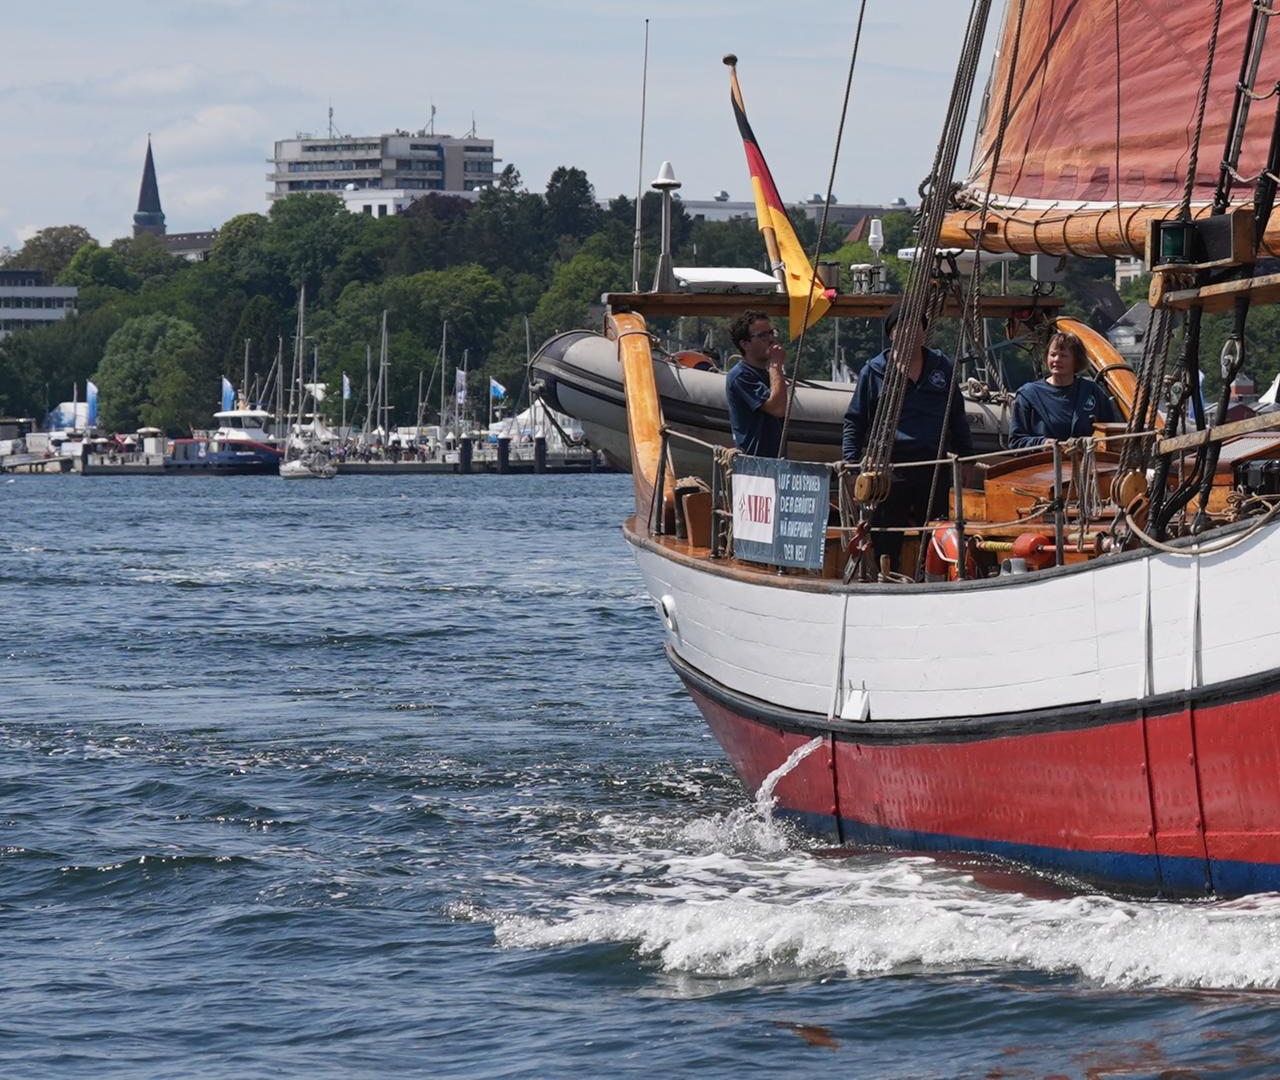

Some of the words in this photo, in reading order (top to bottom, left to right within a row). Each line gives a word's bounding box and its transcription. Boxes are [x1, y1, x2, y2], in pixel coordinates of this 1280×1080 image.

[791, 474, 802, 491] DEN
[747, 495, 772, 524] NIBE
[780, 495, 794, 513] DER
[783, 543, 794, 561] DER
[795, 544, 808, 561] WELT
